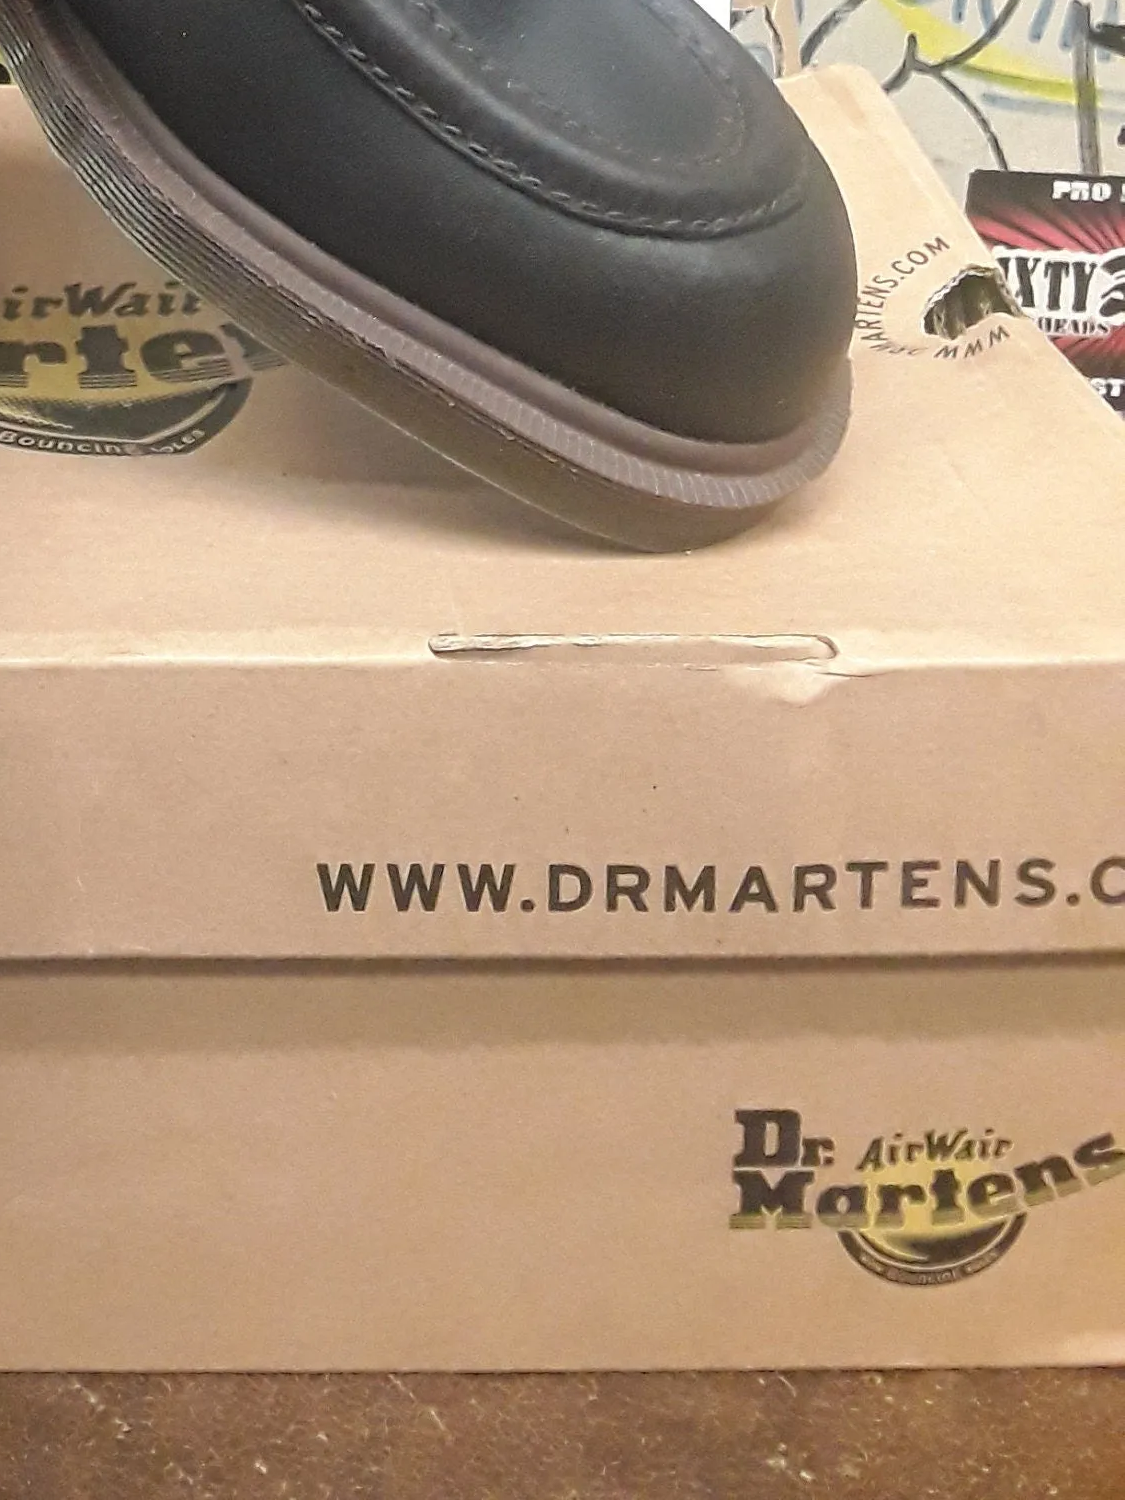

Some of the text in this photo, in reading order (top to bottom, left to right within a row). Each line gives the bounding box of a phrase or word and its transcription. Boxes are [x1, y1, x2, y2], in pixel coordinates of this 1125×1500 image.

[733, 1108, 835, 1168] Dr.
[855, 1128, 1014, 1172] AirWair
[728, 1132, 1125, 1231] Martens
